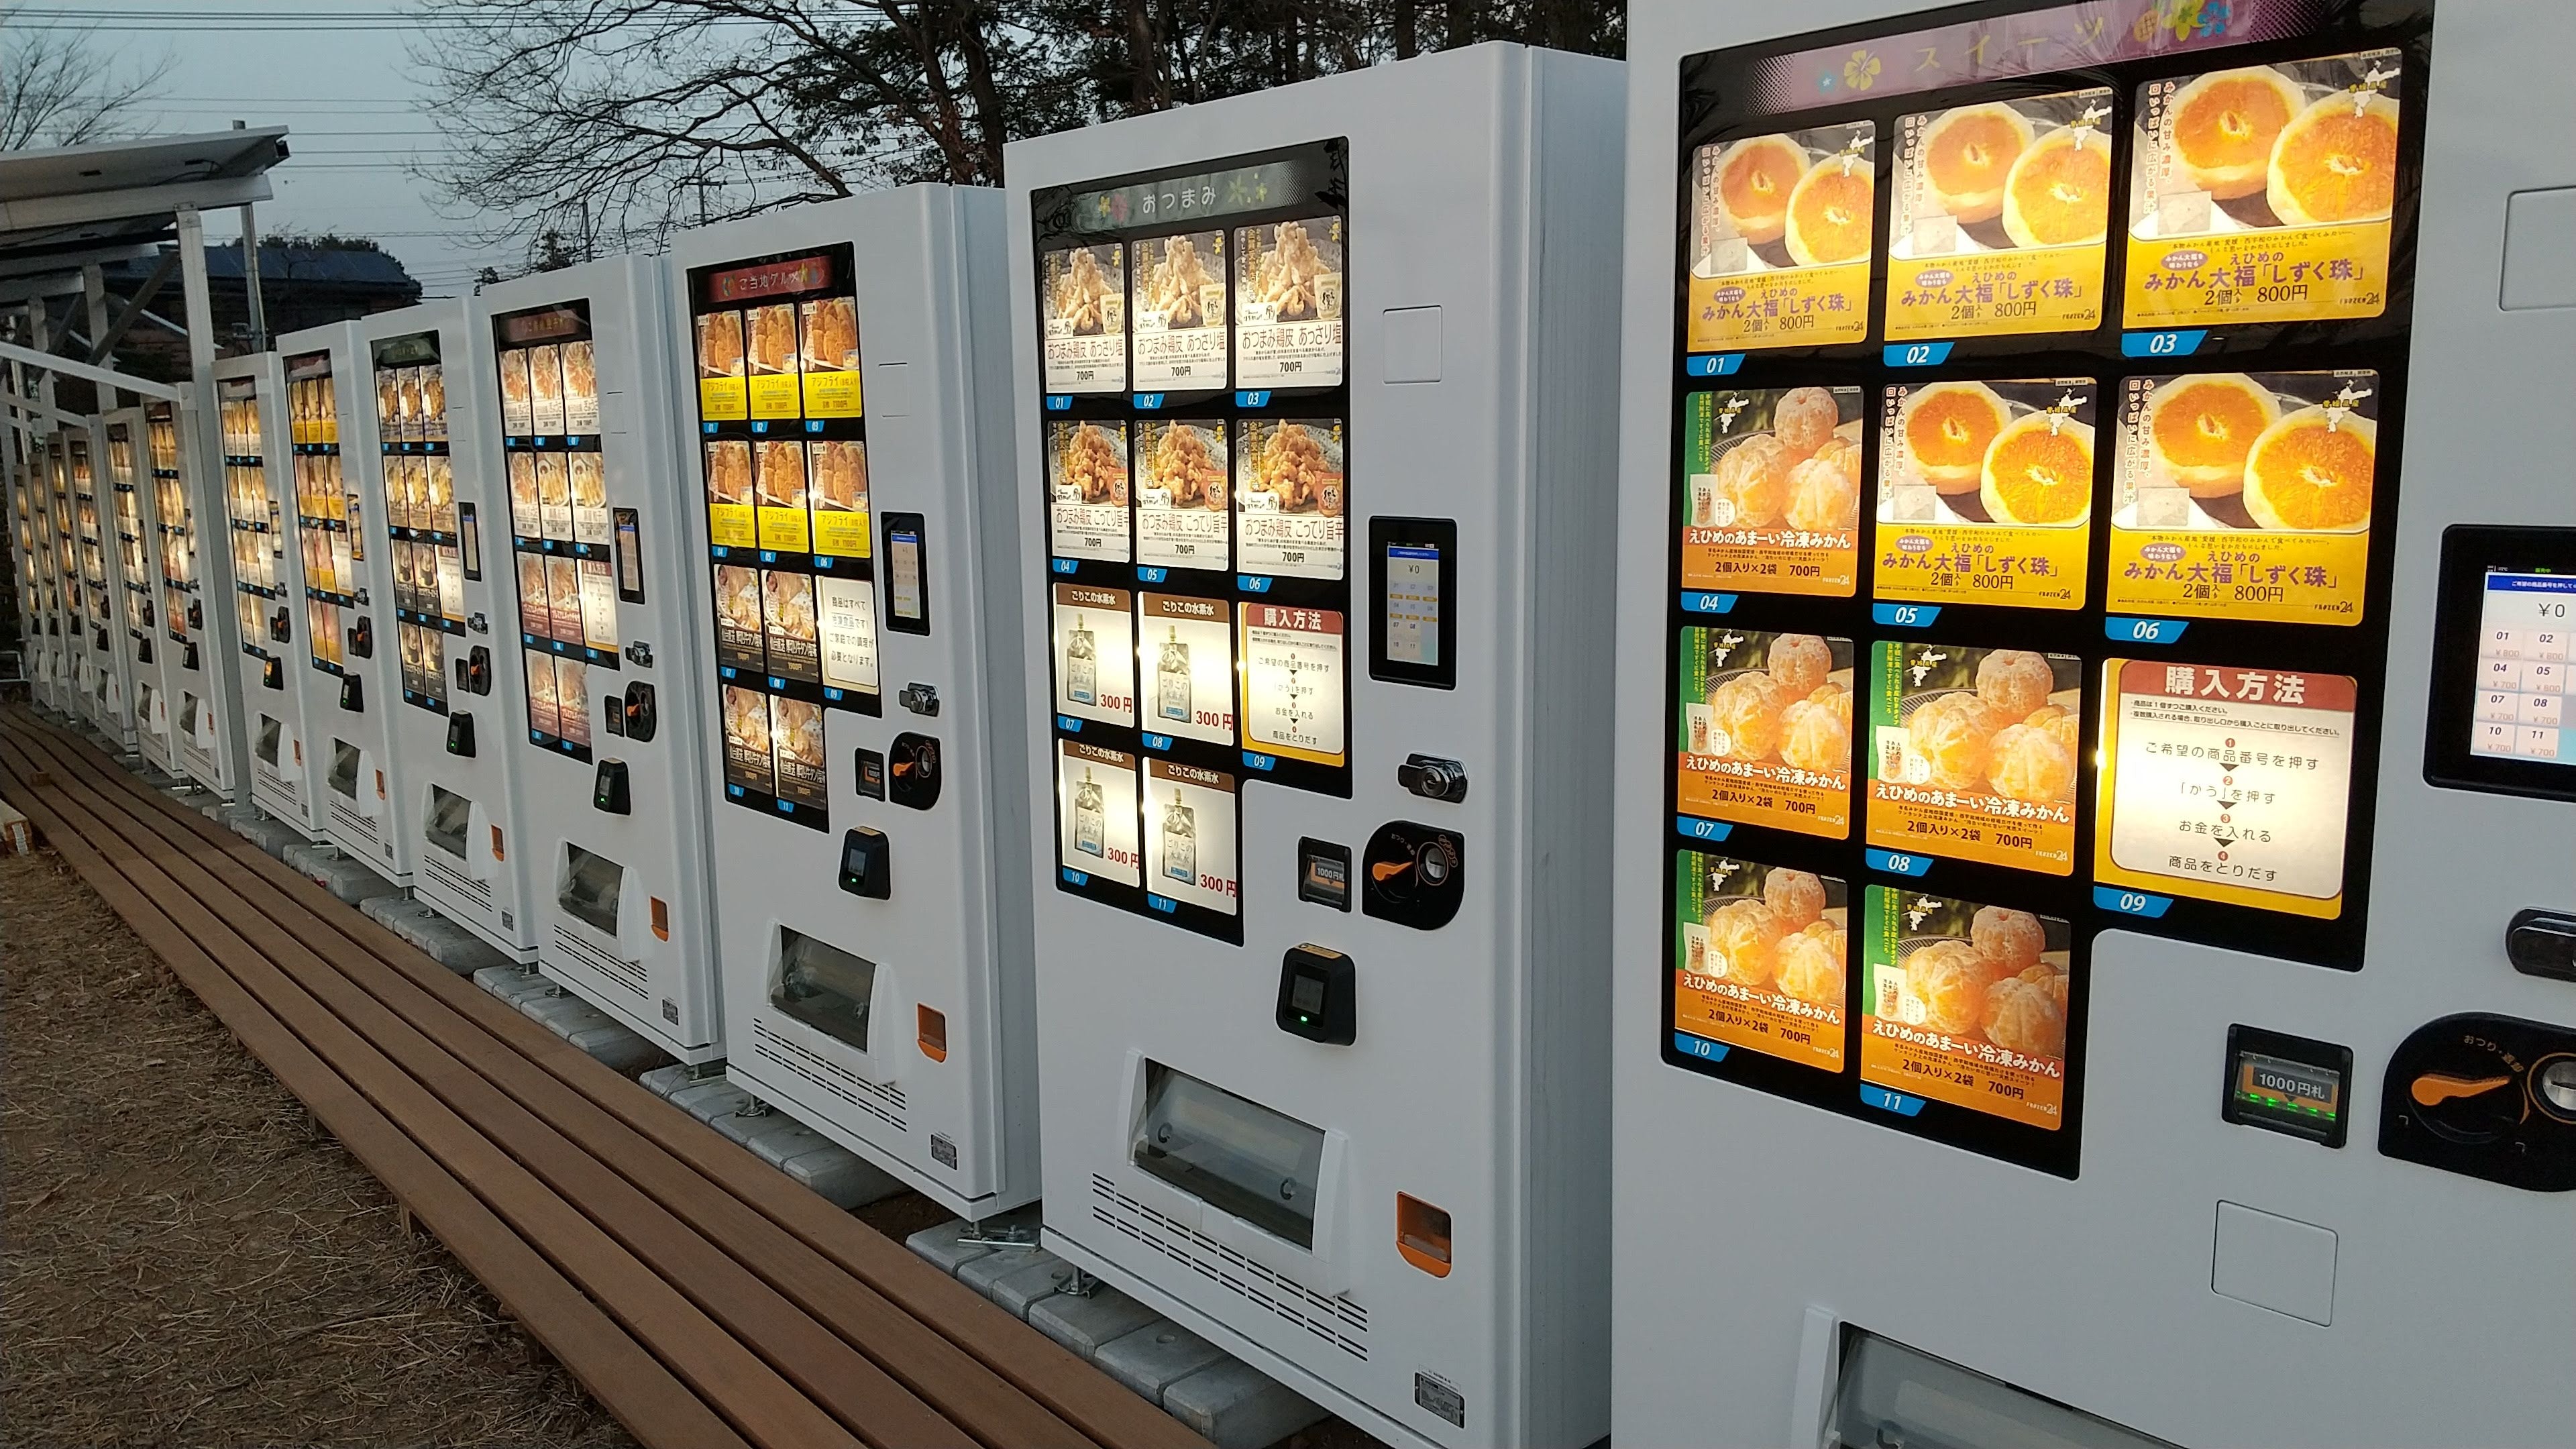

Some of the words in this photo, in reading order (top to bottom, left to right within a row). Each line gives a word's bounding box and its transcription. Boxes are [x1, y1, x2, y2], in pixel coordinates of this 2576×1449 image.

[1915, 17, 2104, 72] スイーツ
[1142, 186, 1216, 214] おつまみ
[2230, 252, 2284, 266] えひめの
[739, 270, 798, 290] ご当地グルメ
[1972, 272, 2017, 284] えひめの
[2144, 259, 2364, 291] みかん大福「しずく珠」
[1760, 288, 1798, 299] えひめの
[1901, 279, 2082, 306] みかん大福「しずく珠」
[2257, 284, 2308, 302] 800円
[1702, 293, 1853, 320] みかん大福「しずく珠」
[1995, 301, 2036, 317] 800円
[1779, 315, 1814, 330] 800円
[1138, 335, 1182, 355] おつまみ鶏皮
[1187, 331, 1225, 351] あっさり塩
[1242, 328, 1293, 350] おつまみ鶏皮
[1299, 323, 1342, 345] あっさり塩
[2150, 334, 2177, 354] 03
[1090, 339, 1123, 357] あっさり塩
[1907, 346, 1929, 364] 02
[1171, 366, 1191, 376] 700円
[1280, 362, 1302, 372] 700円
[1707, 357, 1723, 373] 01
[1077, 370, 1094, 380] 700円
[1056, 398, 1064, 409] 01
[1144, 395, 1153, 407] 02
[1248, 392, 1259, 405] 03
[1142, 513, 1183, 531] おつまみ鶏皮
[1245, 519, 1292, 538] おつまみ鶏皮
[1296, 520, 1344, 541] こってり旨辛
[1085, 538, 1102, 547] 700円
[1689, 529, 1851, 549] えひめのあまーい冷凍みかん
[1175, 545, 1195, 555] 700円
[1951, 543, 1994, 553] えひめの
[1282, 551, 1305, 562] 700円
[1882, 552, 2058, 577] みかん大福「しずく珠」
[2208, 551, 2260, 562] えひめの
[1061, 561, 1070, 572] 04
[1147, 569, 1157, 580] 05
[1715, 562, 1777, 575] 2個入り×2袋
[1789, 565, 1820, 576] 700円
[1972, 575, 2013, 590] 800円
[2124, 562, 2337, 588] みかん大福「しずく珠」
[1249, 578, 1260, 590] 06
[2235, 586, 2284, 602] 800円
[832, 596, 866, 610] 商品はすべて
[1700, 596, 1718, 610] 04
[1264, 608, 1322, 631] 購入方法
[1895, 607, 1918, 623] 05
[2133, 621, 2159, 639] 06
[2496, 631, 2509, 640] 01
[2539, 635, 2553, 643] 02
[2493, 663, 2508, 672] 04
[2536, 667, 2551, 676] 05
[2165, 666, 2306, 705] 購入方法
[1100, 694, 1120, 710] 300
[1123, 696, 1132, 713] 円
[2491, 695, 2505, 704] 07
[2534, 698, 2548, 707] 08
[1195, 710, 1219, 727] 300
[1222, 713, 1232, 731] 円
[1275, 708, 1313, 720] お金を入れる
[1066, 718, 1074, 729] 07
[2489, 727, 2502, 735] 10
[1152, 736, 1163, 747] 08
[1273, 731, 1318, 745] 商品をとりだす
[2532, 731, 2544, 739] 11
[1254, 755, 1265, 767] 09
[2147, 742, 2320, 770] ご希望の商品番号を押す
[1686, 755, 1846, 790] えひめのあまーい冷凍みかん
[2180, 782, 2275, 804] 「かう」を押す
[1712, 789, 1772, 808] 2個入り×2袋
[1785, 800, 1816, 814] 700円
[1876, 784, 2070, 823] えひめのあまーい冷凍みかん
[1695, 822, 1714, 837] 07
[1907, 821, 1980, 842] 2個入り×2袋
[1996, 833, 2033, 849] 700円
[2180, 820, 2271, 843] お金を入れる
[1108, 848, 1128, 864] 300
[1888, 855, 1911, 871] 08
[2169, 855, 2277, 881] 商品をとりだす
[1071, 872, 1079, 883] 10
[1200, 874, 1223, 892] 300
[1226, 879, 1236, 897] 円
[1159, 898, 1167, 910] 11
[2120, 894, 2146, 912] 09
[1684, 973, 1840, 1025] えひめのあまーい冷凍みかん
[1708, 1009, 1768, 1033] 2個入り×2袋
[1780, 1028, 1811, 1044] 700円
[1694, 1041, 1710, 1057] 10
[1872, 1020, 2060, 1079] えひめのあまーい冷凍みかん
[1902, 1059, 1974, 1087] 2個入り×2袋
[1988, 1081, 2024, 1099] 700円
[2259, 1072, 2324, 1099] 1000円札
[1884, 1092, 1901, 1110] 11
